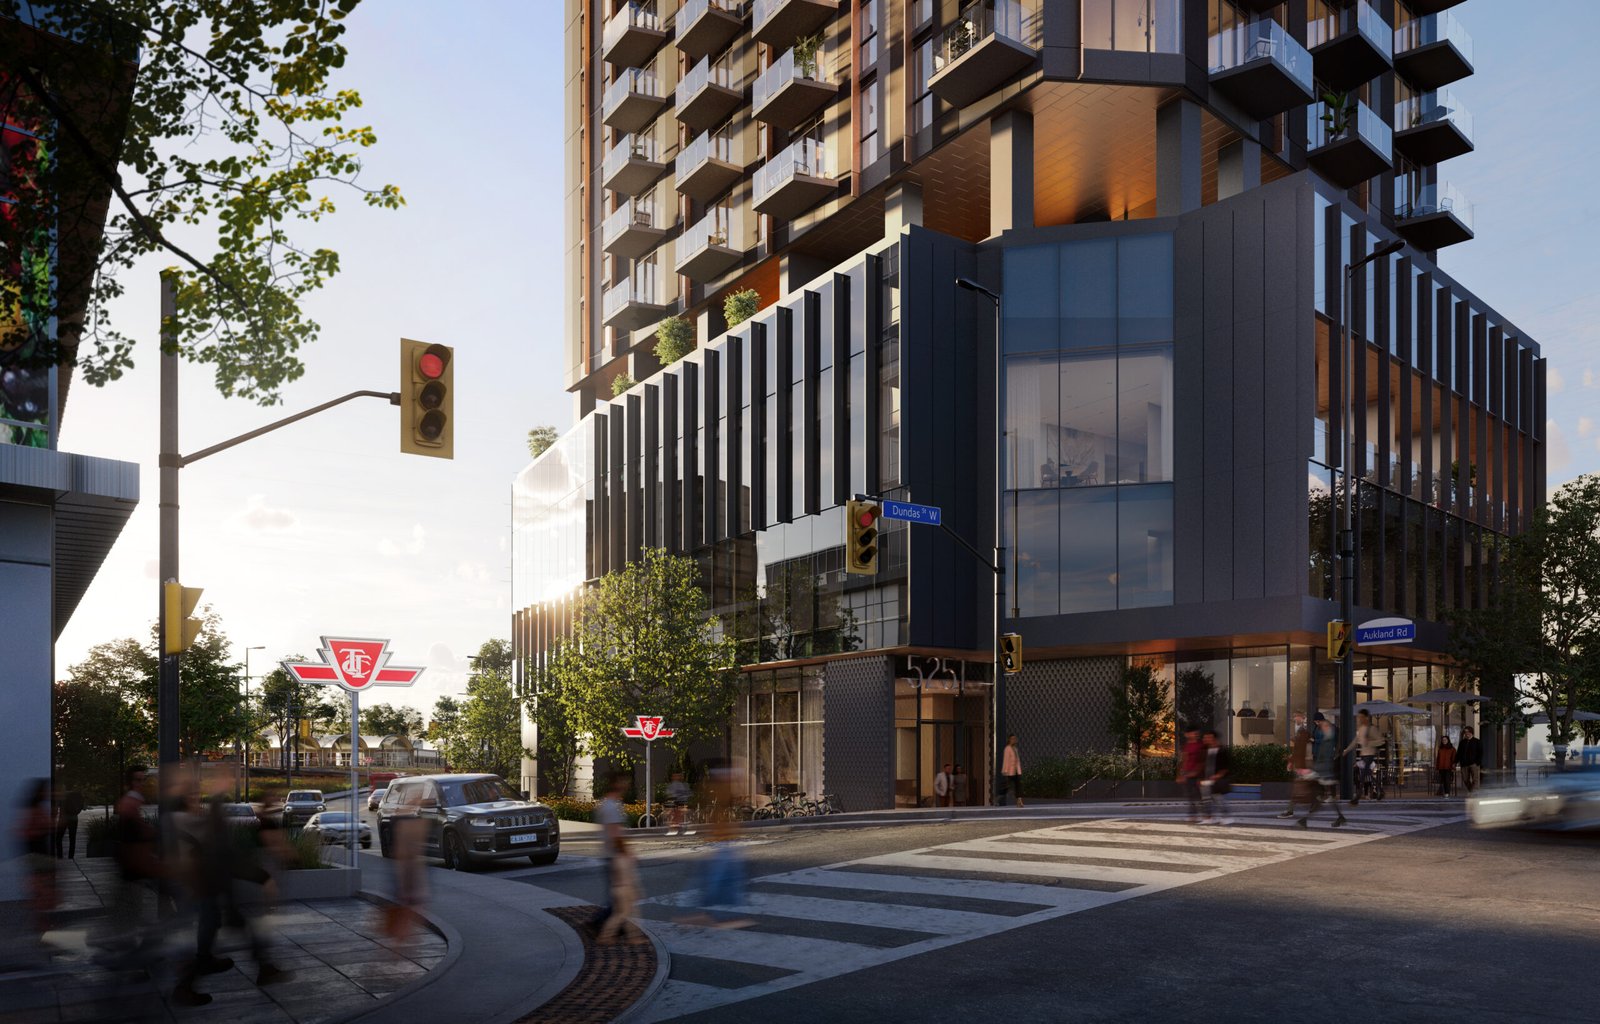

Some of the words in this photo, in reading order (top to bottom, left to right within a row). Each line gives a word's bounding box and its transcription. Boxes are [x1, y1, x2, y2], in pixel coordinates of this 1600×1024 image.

[892, 505, 920, 518] Dundas
[929, 510, 938, 520] W
[1362, 629, 1394, 640] Aukland
[1396, 627, 1408, 637] Rd
[902, 654, 965, 692] 5251
